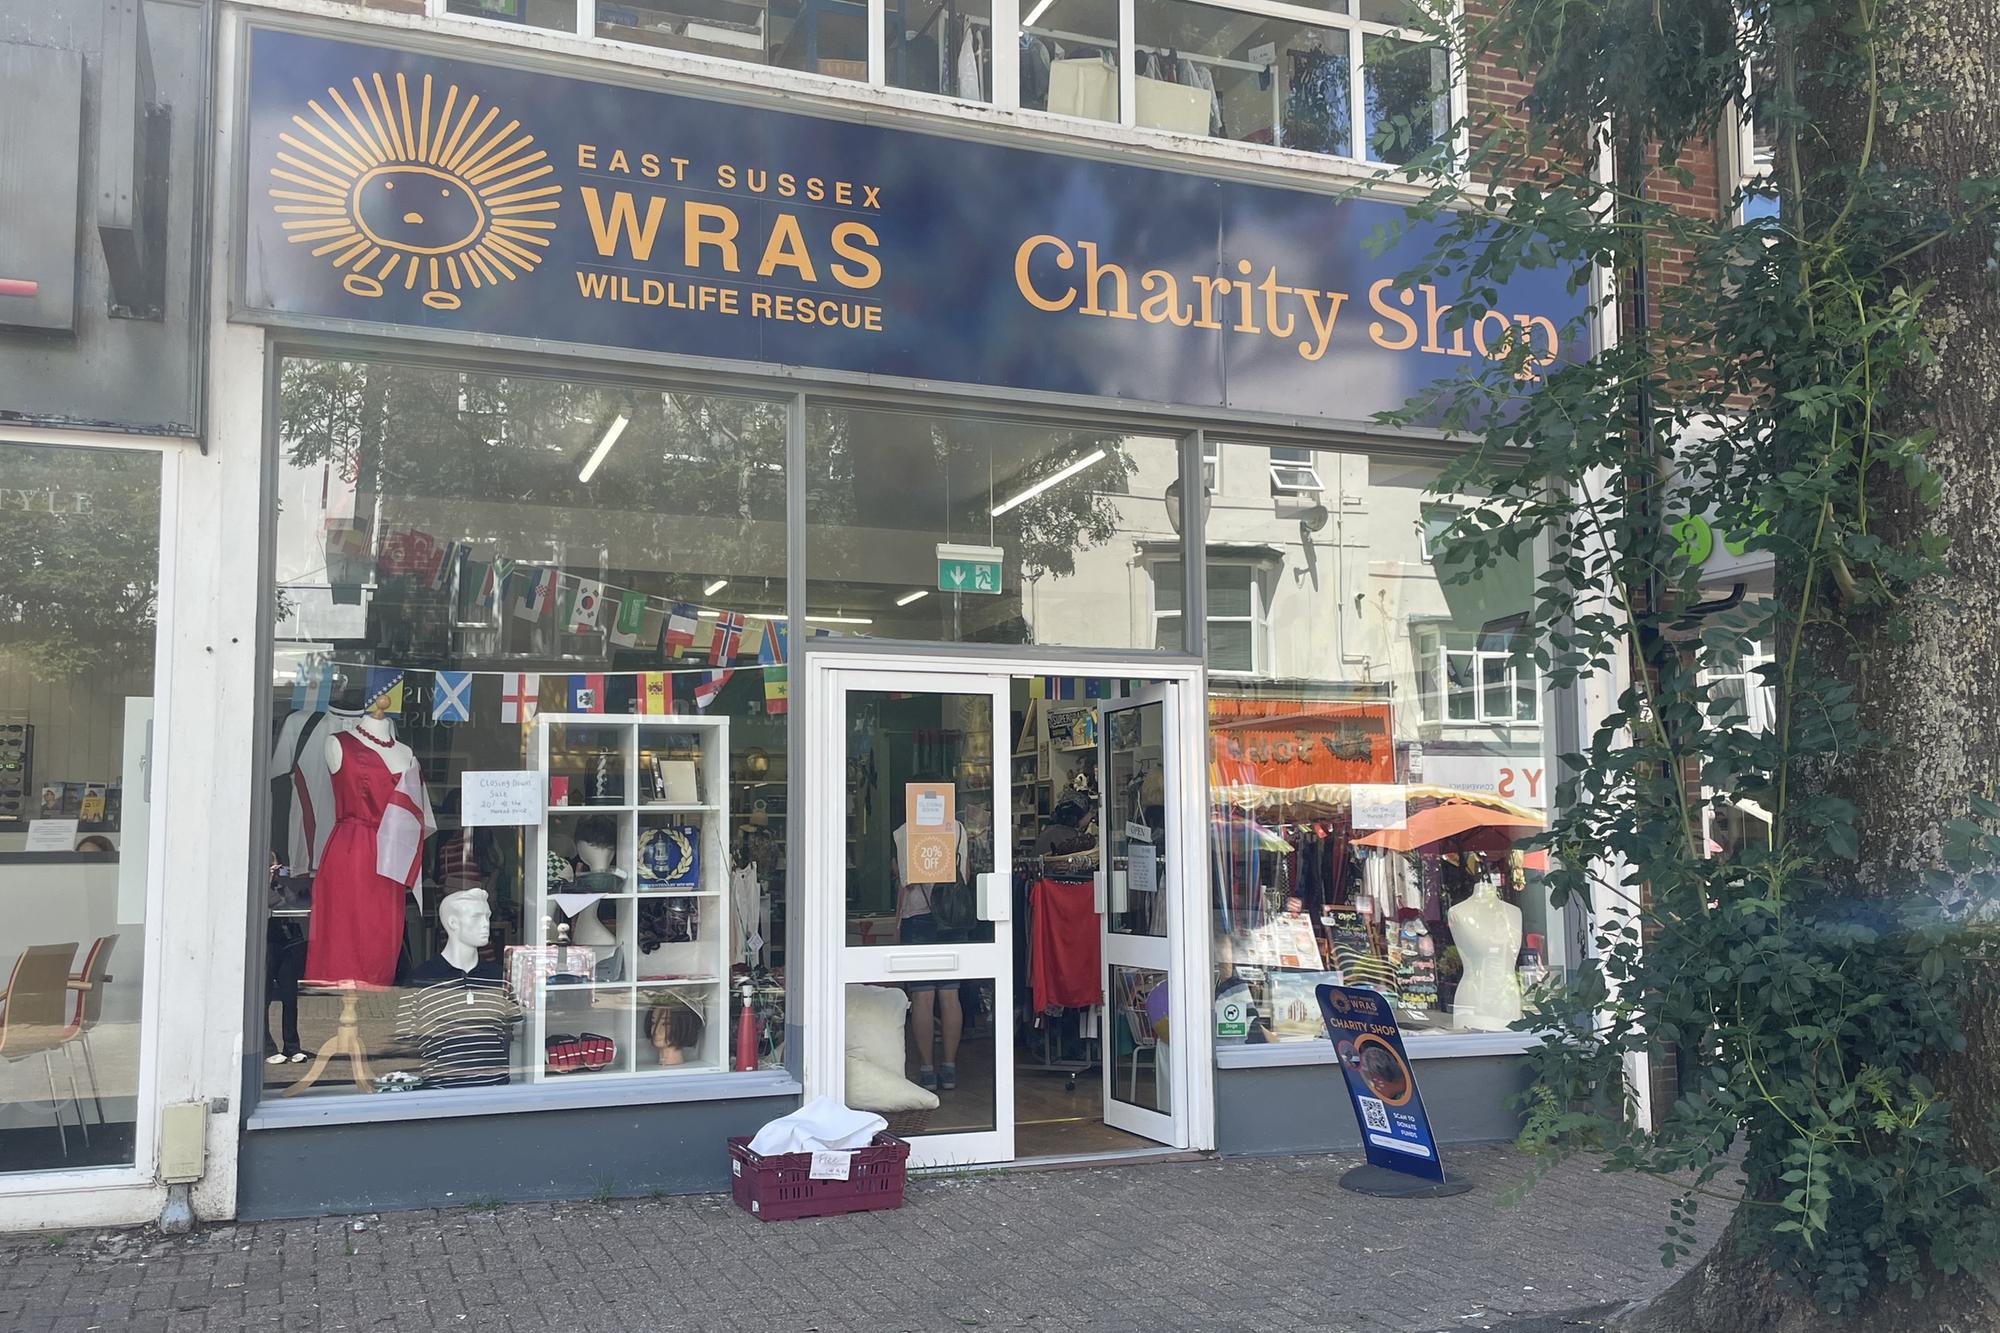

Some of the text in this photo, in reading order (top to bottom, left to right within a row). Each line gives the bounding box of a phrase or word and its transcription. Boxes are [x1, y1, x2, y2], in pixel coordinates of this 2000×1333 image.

[578, 143, 882, 210] EAST SUSSEX
[579, 186, 883, 290] WRAS
[576, 271, 883, 332] WILDLIFE RESCUE
[1014, 234, 1560, 383] Charity Shop
[480, 779, 511, 788] Closing
[1130, 825, 1146, 838] OPEN
[920, 847, 943, 858] 20%
[923, 857, 940, 870] OFF
[1350, 999, 1378, 1012] WRAS
[1330, 1017, 1396, 1037] CHARITY SHOP
[1396, 1121, 1418, 1131] DONATE
